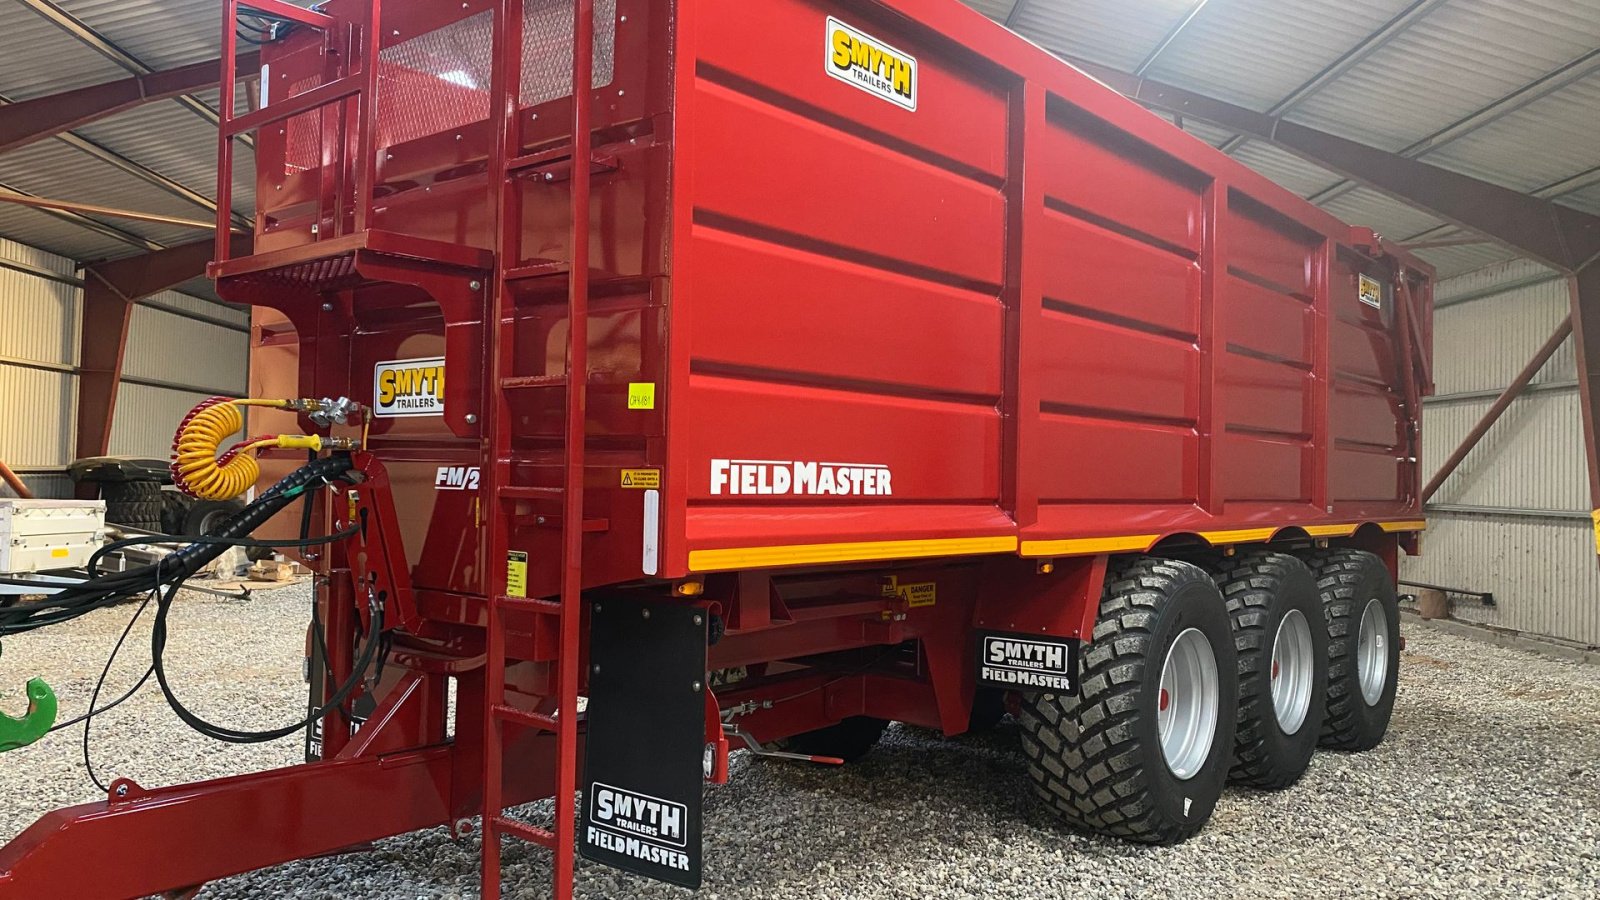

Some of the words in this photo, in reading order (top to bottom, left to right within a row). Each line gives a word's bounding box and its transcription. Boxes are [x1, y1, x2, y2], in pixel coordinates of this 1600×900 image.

[833, 30, 911, 99] SMYTH
[853, 69, 891, 93] TRAILERS
[397, 398, 434, 409] TRAILERS
[435, 467, 480, 490] FM/2
[710, 459, 892, 495] FIELDMASTER
[990, 641, 1062, 669] SMYTH
[1008, 659, 1044, 669] TRAILERS
[982, 666, 1070, 690] FIELDMASTER
[597, 789, 680, 839] SMYTH
[616, 818, 658, 837] TRAILERS
[587, 826, 690, 871] FIELDMASTER
